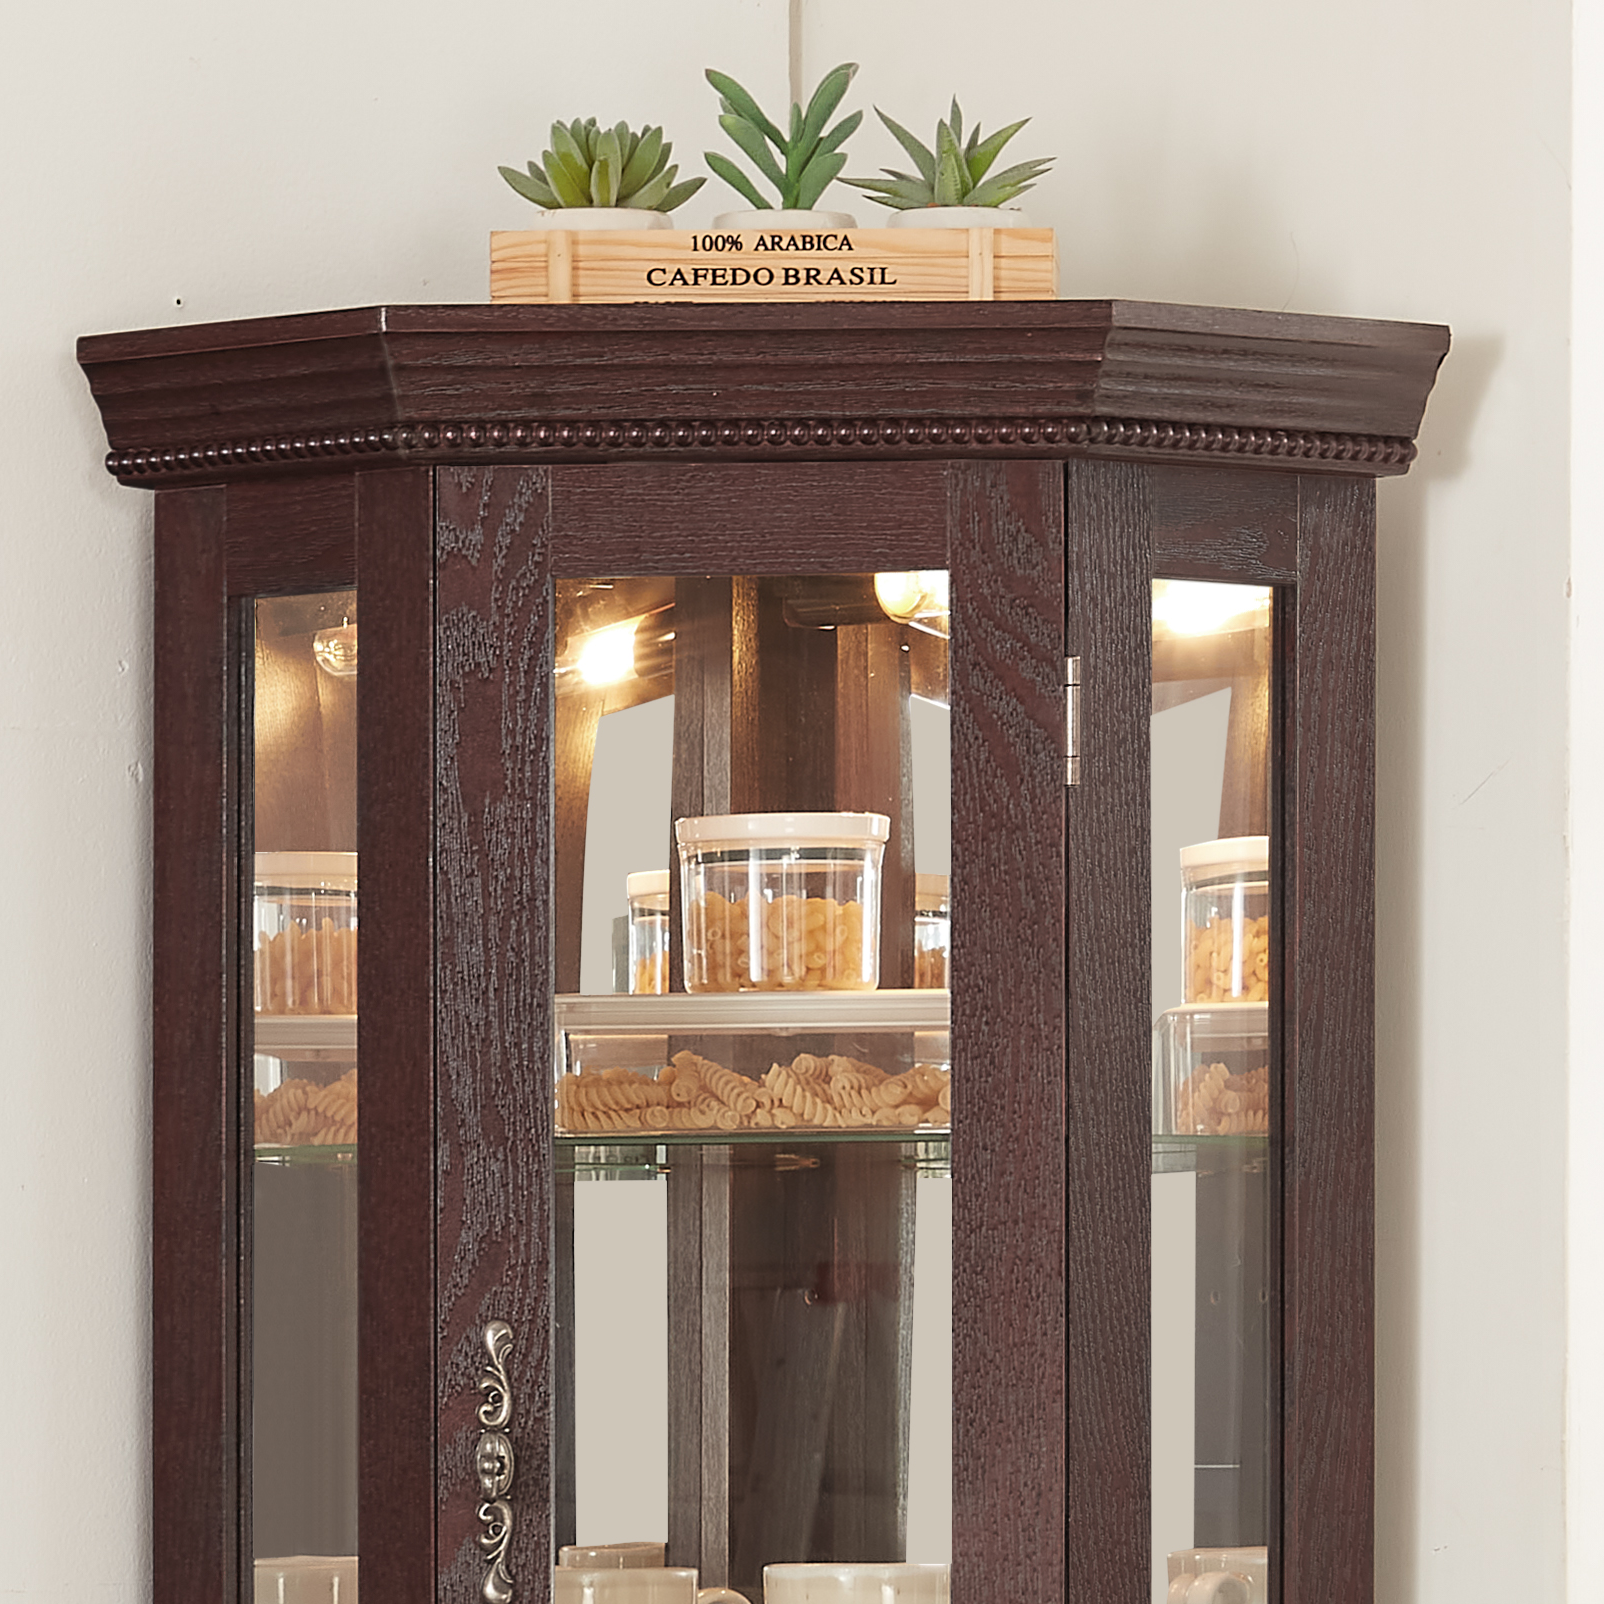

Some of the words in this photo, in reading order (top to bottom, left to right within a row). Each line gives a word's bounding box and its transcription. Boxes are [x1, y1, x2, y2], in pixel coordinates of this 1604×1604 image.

[691, 234, 743, 251] 100%
[753, 234, 854, 251] ARABICA
[646, 267, 775, 286] CAFEDO
[781, 266, 897, 286] BRASIL
